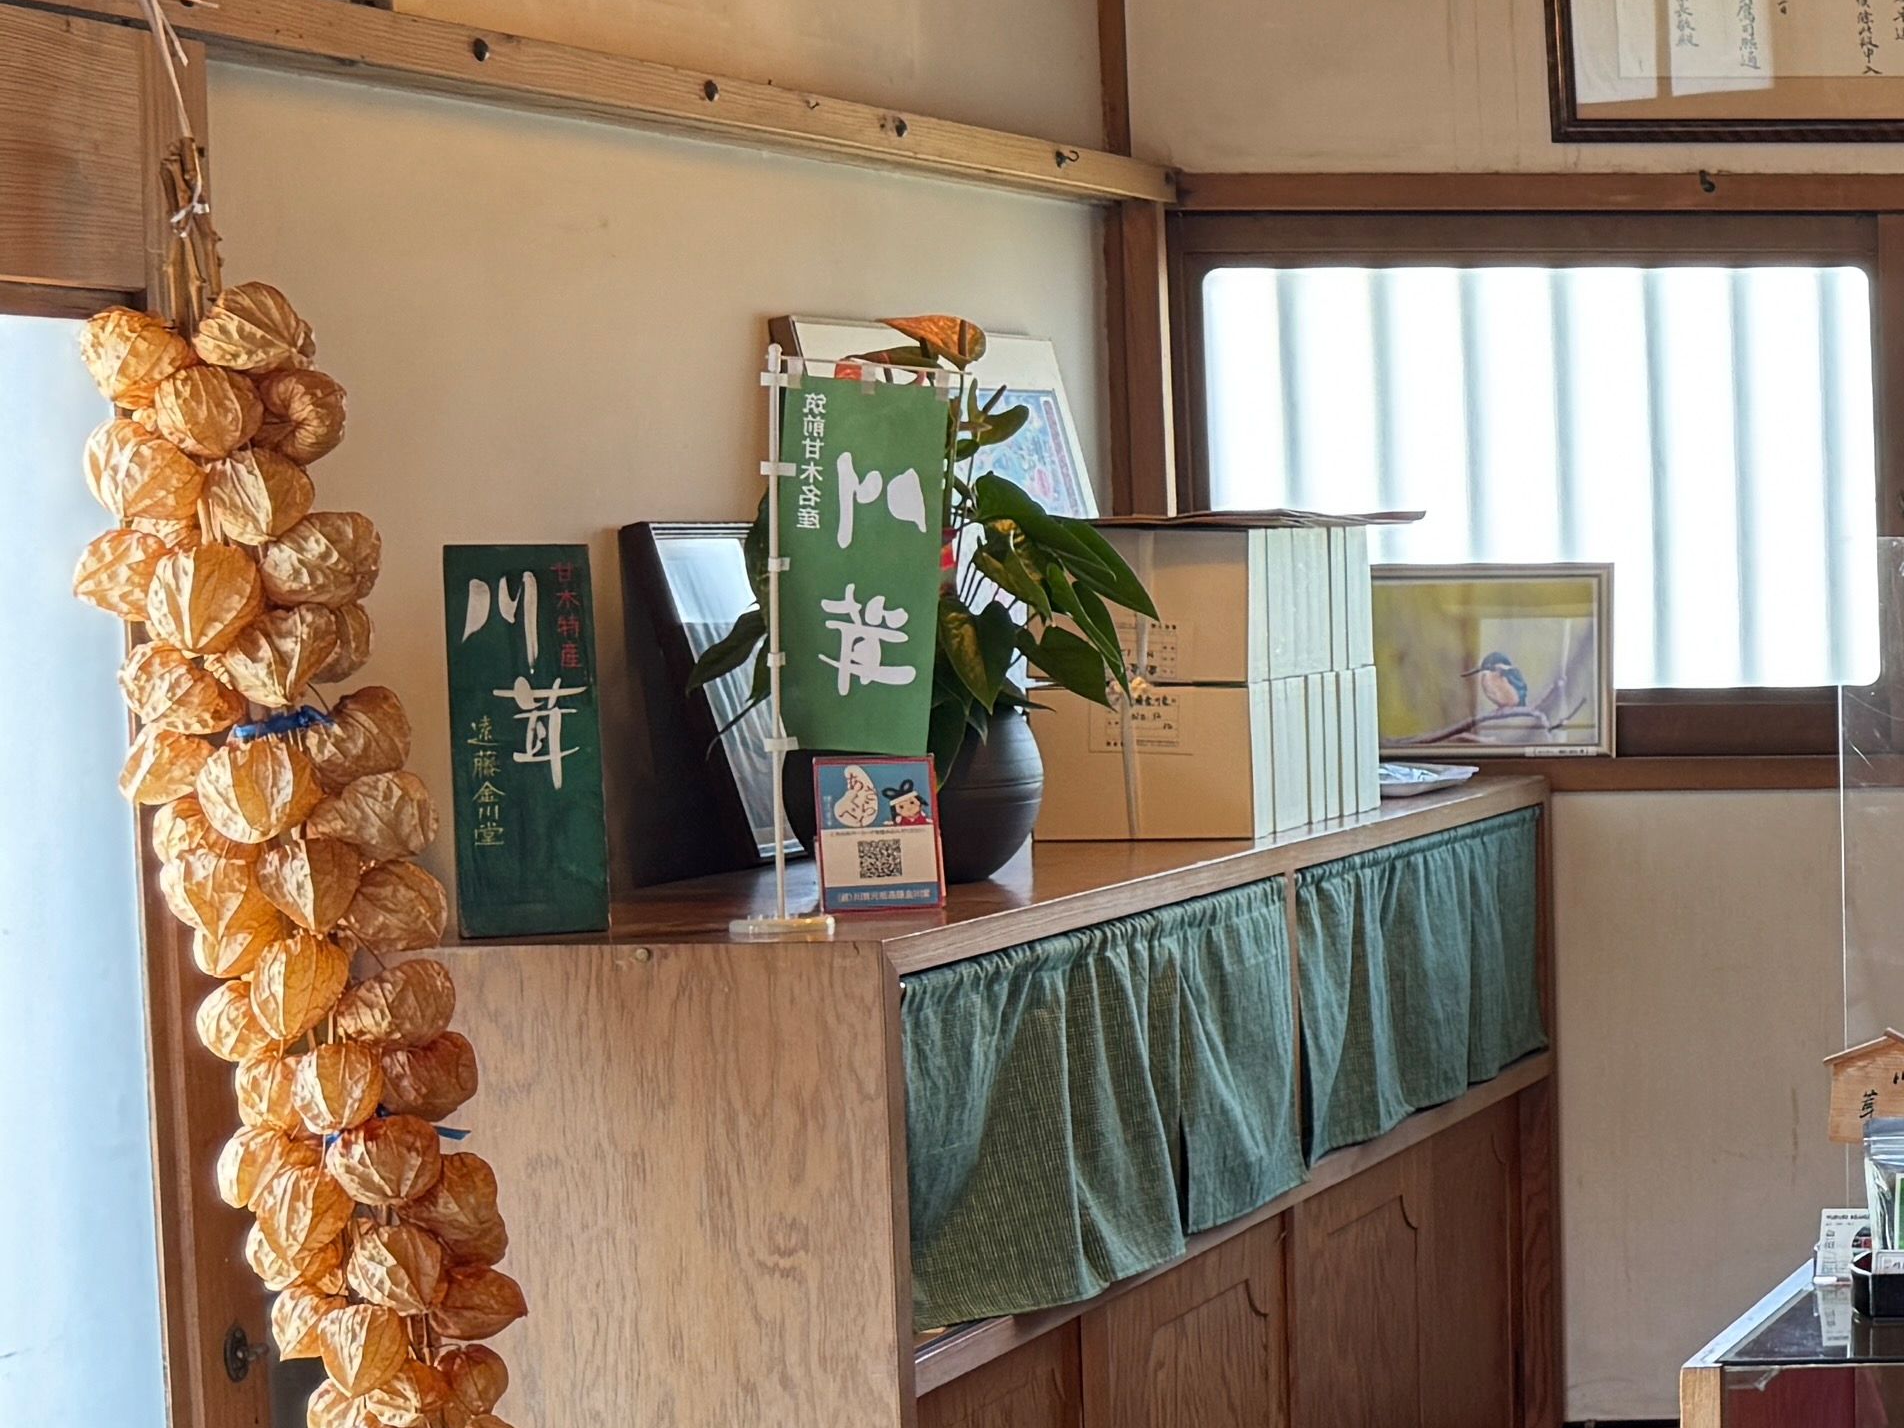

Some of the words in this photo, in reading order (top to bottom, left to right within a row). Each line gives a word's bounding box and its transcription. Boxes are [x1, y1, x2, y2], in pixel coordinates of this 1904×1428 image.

[460, 570, 588, 790] 川茸
[550, 561, 584, 669] 甘木特産
[466, 715, 506, 847] 遠藤金川堂
